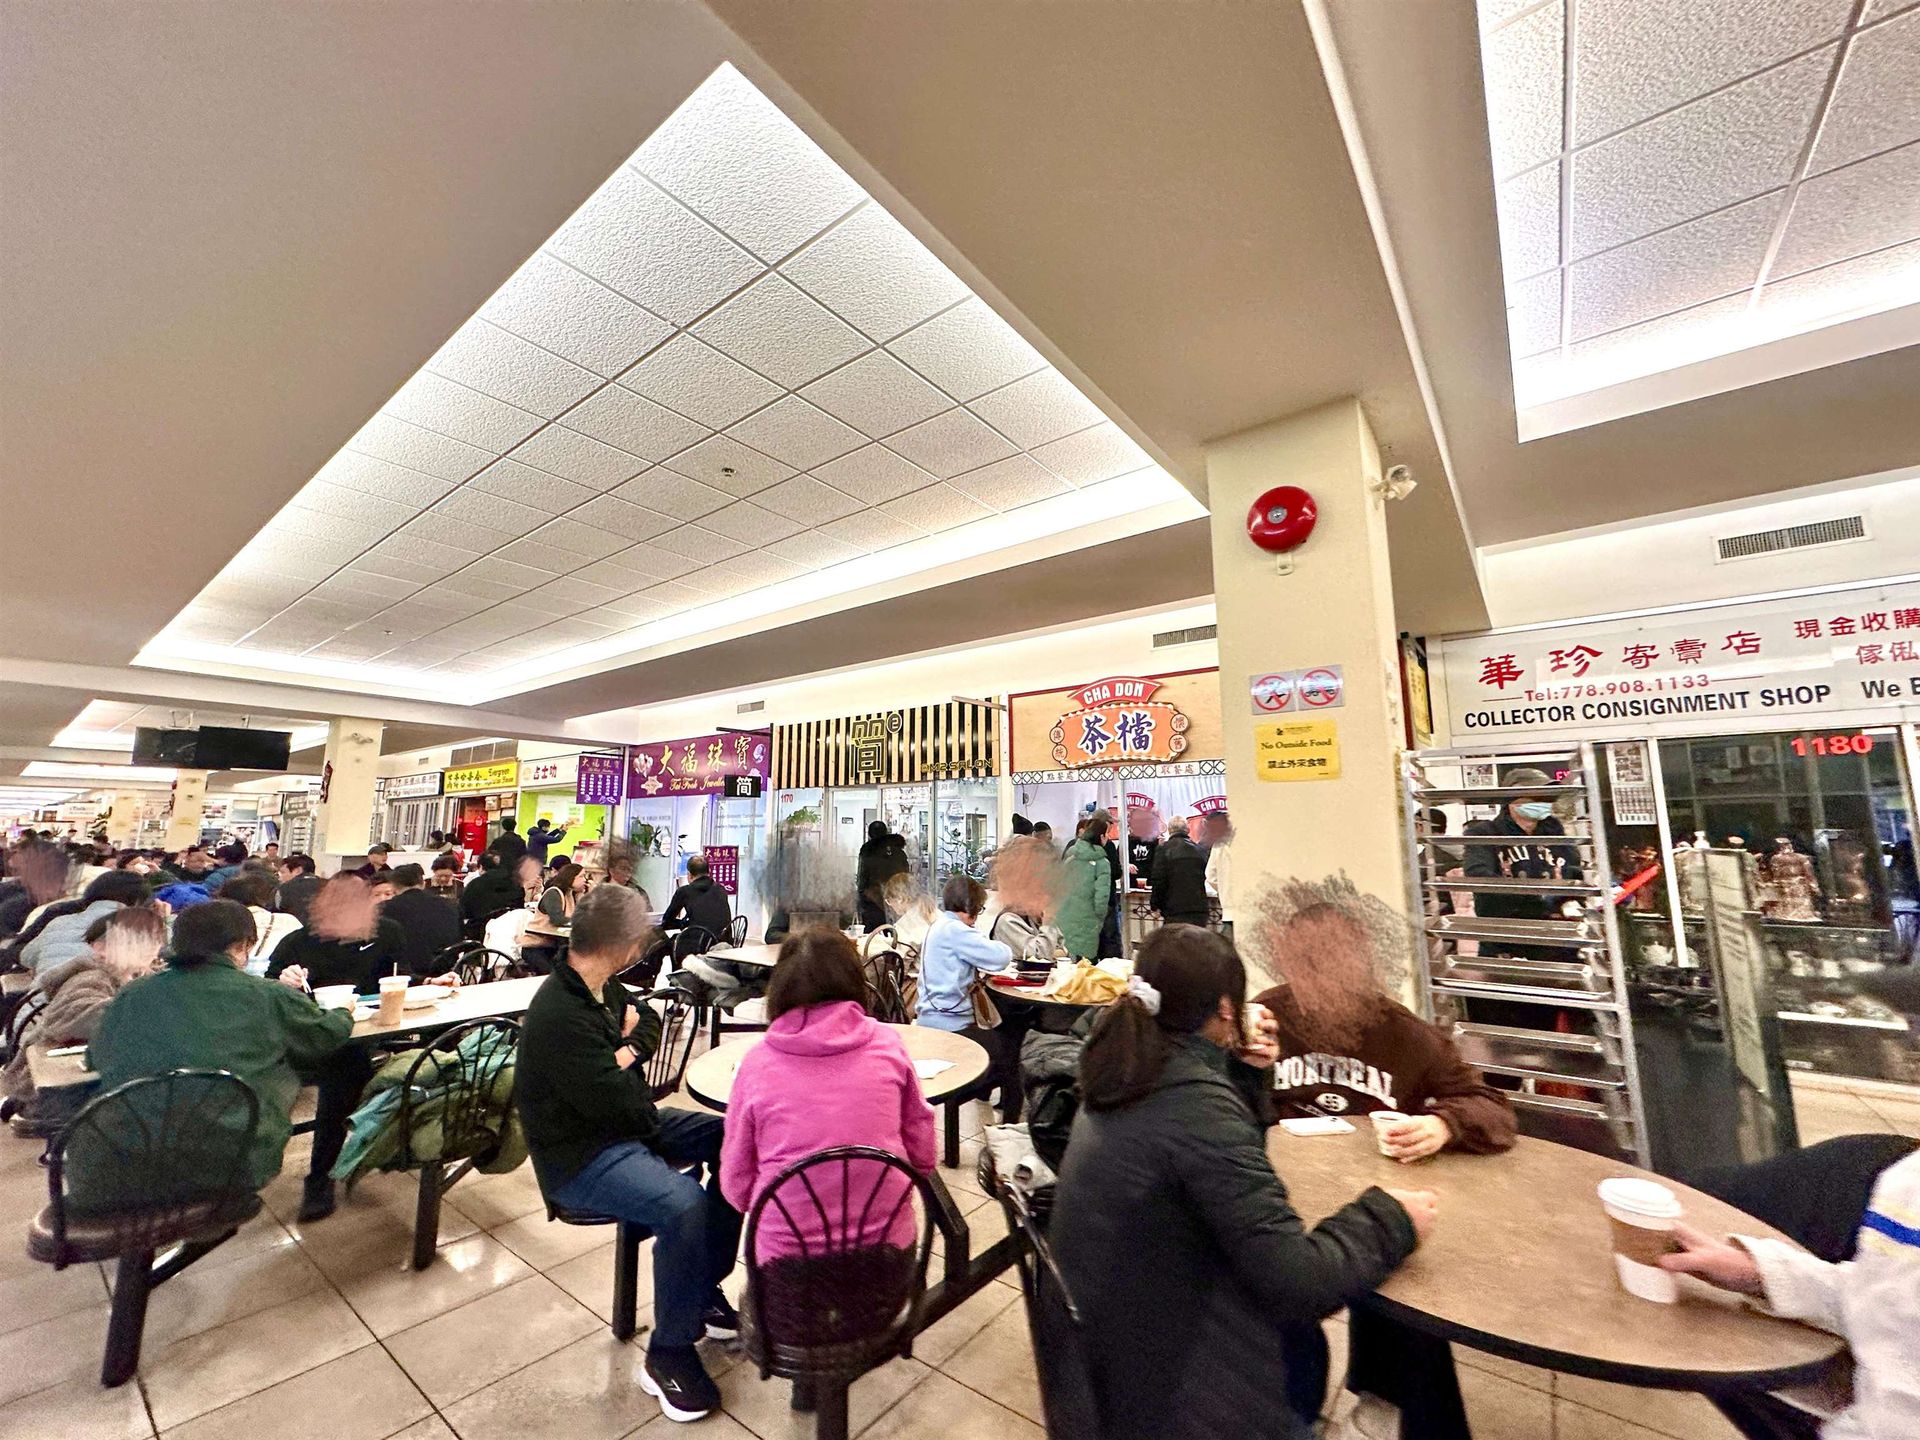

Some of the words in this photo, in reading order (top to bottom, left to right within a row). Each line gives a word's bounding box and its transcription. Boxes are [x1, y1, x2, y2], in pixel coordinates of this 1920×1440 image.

[1479, 631, 1762, 690] 華珍寄賣店
[1083, 685, 1111, 705] CHA
[1861, 679, 1901, 699] We
[1465, 704, 1576, 728] COLLECTOR
[1582, 690, 1750, 720] CONSIGNMENT
[1759, 684, 1832, 707] SHOP
[1080, 712, 1153, 755] 茶檔
[1261, 742, 1274, 750] No
[1310, 738, 1332, 747] Food
[1790, 733, 1874, 757] 1180
[658, 736, 752, 777] 大福珠寶
